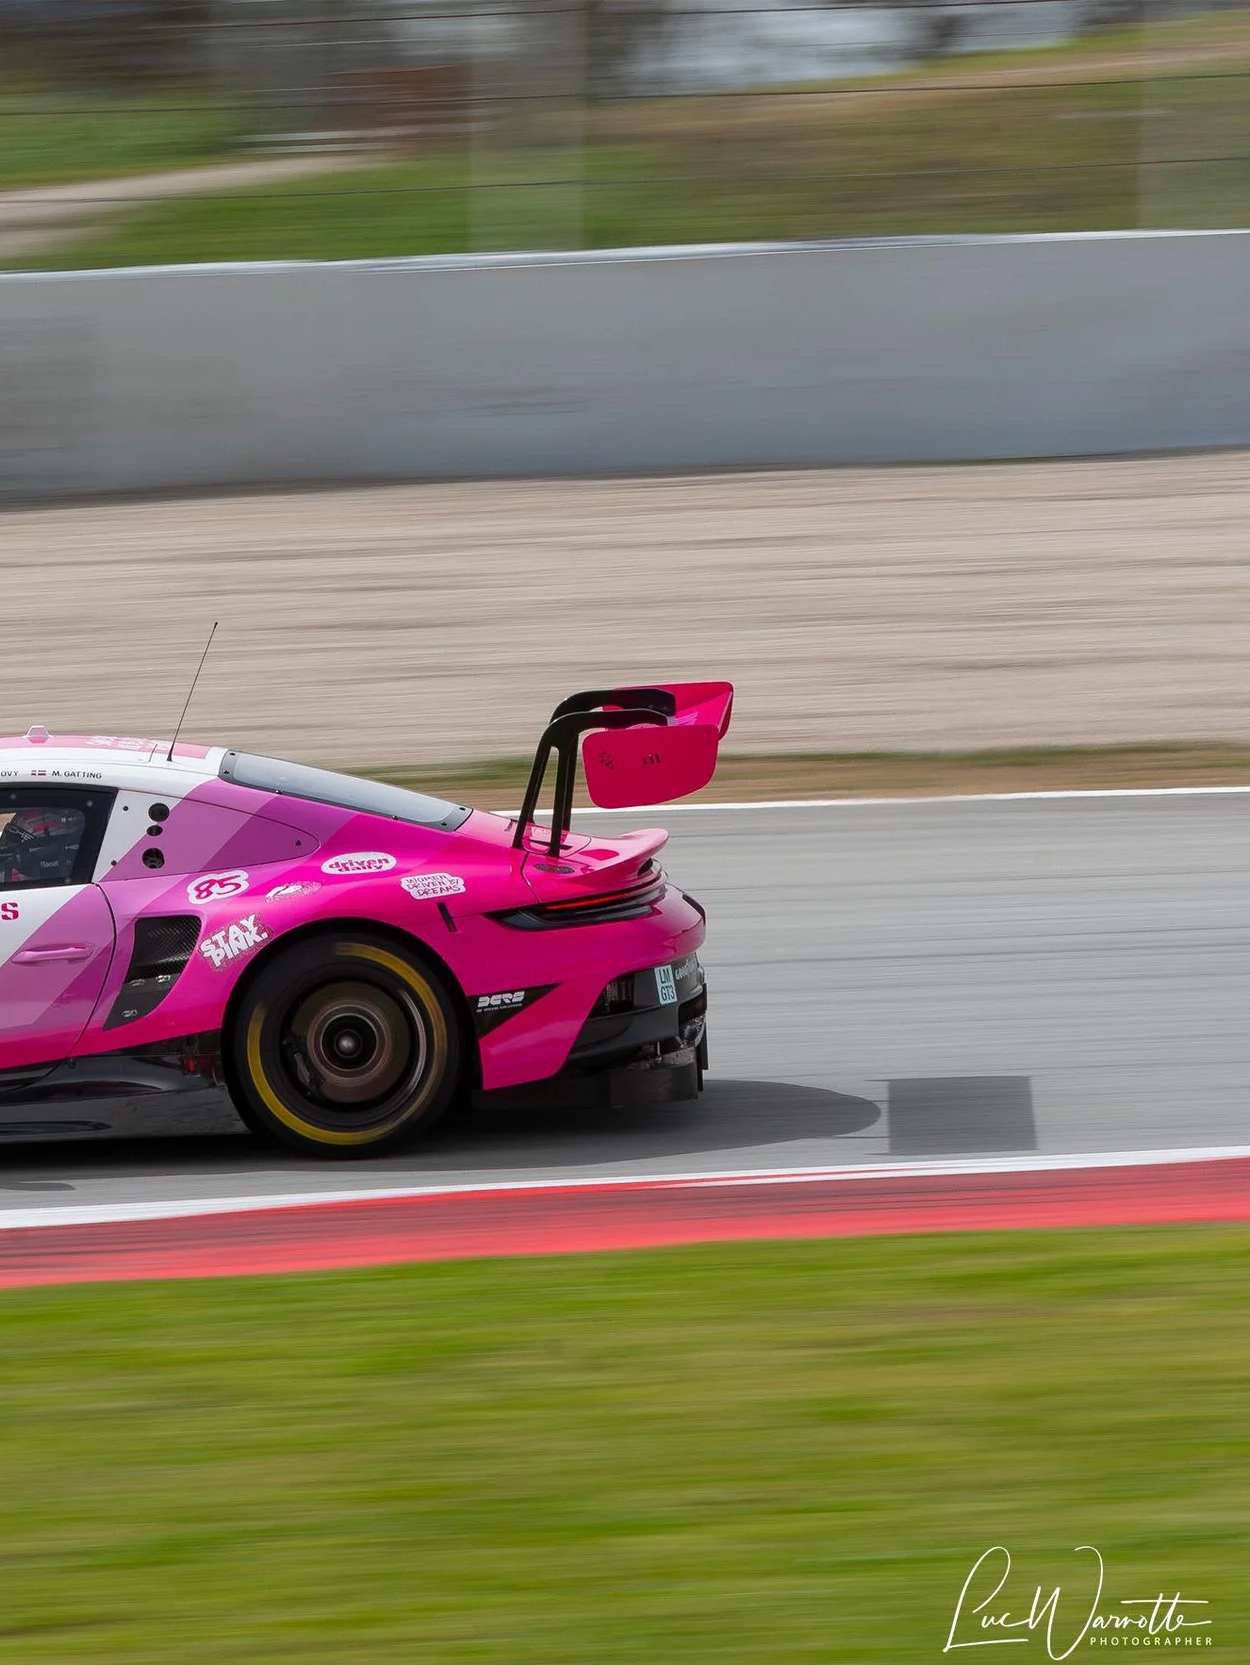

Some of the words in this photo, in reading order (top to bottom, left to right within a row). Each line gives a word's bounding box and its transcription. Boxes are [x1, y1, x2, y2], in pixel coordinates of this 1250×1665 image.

[63, 770, 102, 780] GATTING
[193, 874, 242, 900] 85
[417, 885, 461, 896] DREAMS
[200, 914, 256, 957] STAY
[658, 967, 671, 984] LM
[660, 984, 675, 1002] GT3
